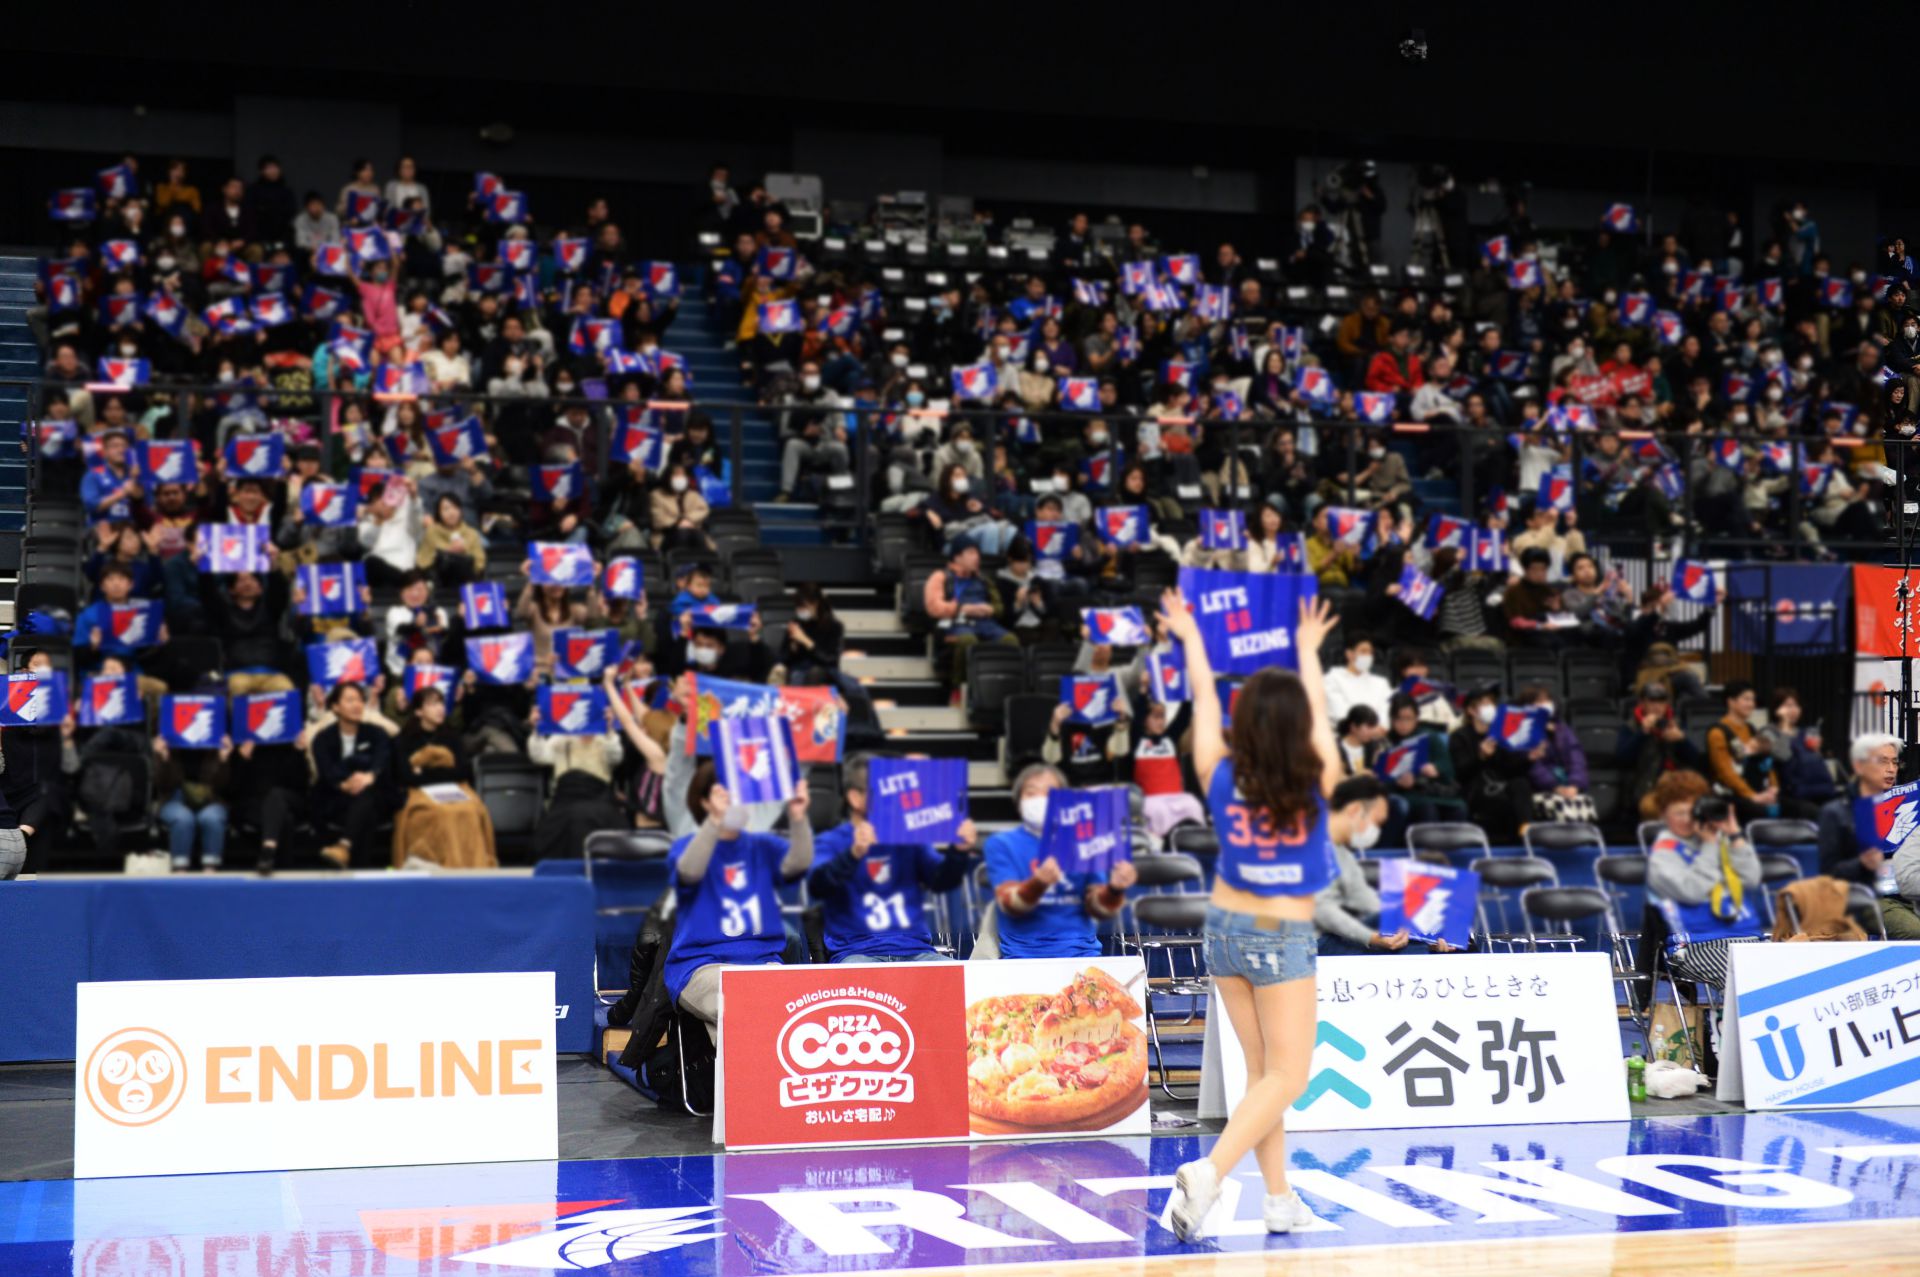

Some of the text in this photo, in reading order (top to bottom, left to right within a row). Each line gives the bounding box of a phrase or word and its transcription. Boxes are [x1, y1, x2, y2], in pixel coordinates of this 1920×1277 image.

[1201, 587, 1248, 614] LET'S
[1226, 608, 1252, 632] GO
[1230, 627, 1290, 657] RIZING
[878, 771, 919, 796] LET'S
[901, 790, 922, 810] GO
[1060, 802, 1093, 825] LET'S
[905, 802, 953, 831] RIZING
[1078, 832, 1116, 859] RIZING
[720, 894, 762, 937] 31
[862, 892, 910, 930] 31
[785, 986, 907, 1013] Delicious&Healthy
[827, 1014, 882, 1032] PIZZA
[205, 1040, 544, 1104] ENDLINE
[1382, 1017, 1566, 1108] 谷弥
[786, 1074, 908, 1101] ピザクック
[1765, 1077, 1826, 1103] HAPPY HOUSE
[805, 1107, 883, 1124] おいしさ宅配
[727, 1154, 1854, 1256] RIZING
